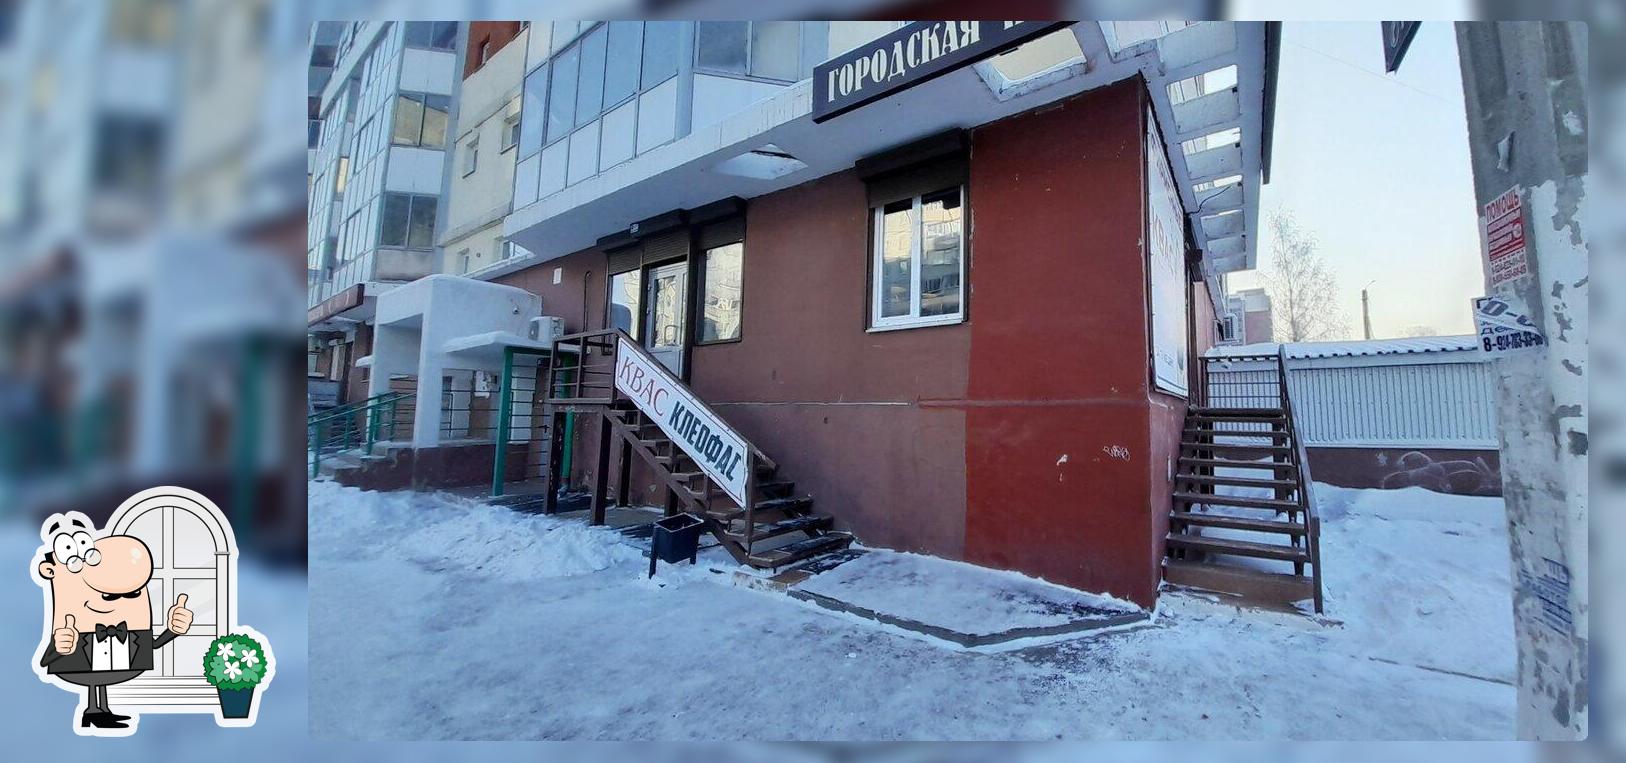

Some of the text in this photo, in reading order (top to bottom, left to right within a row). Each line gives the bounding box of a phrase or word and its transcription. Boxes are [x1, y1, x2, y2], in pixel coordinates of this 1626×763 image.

[827, 21, 981, 103] ГОРОДСКАЯ
[619, 356, 742, 482] КВАС КЛЕОФАС
